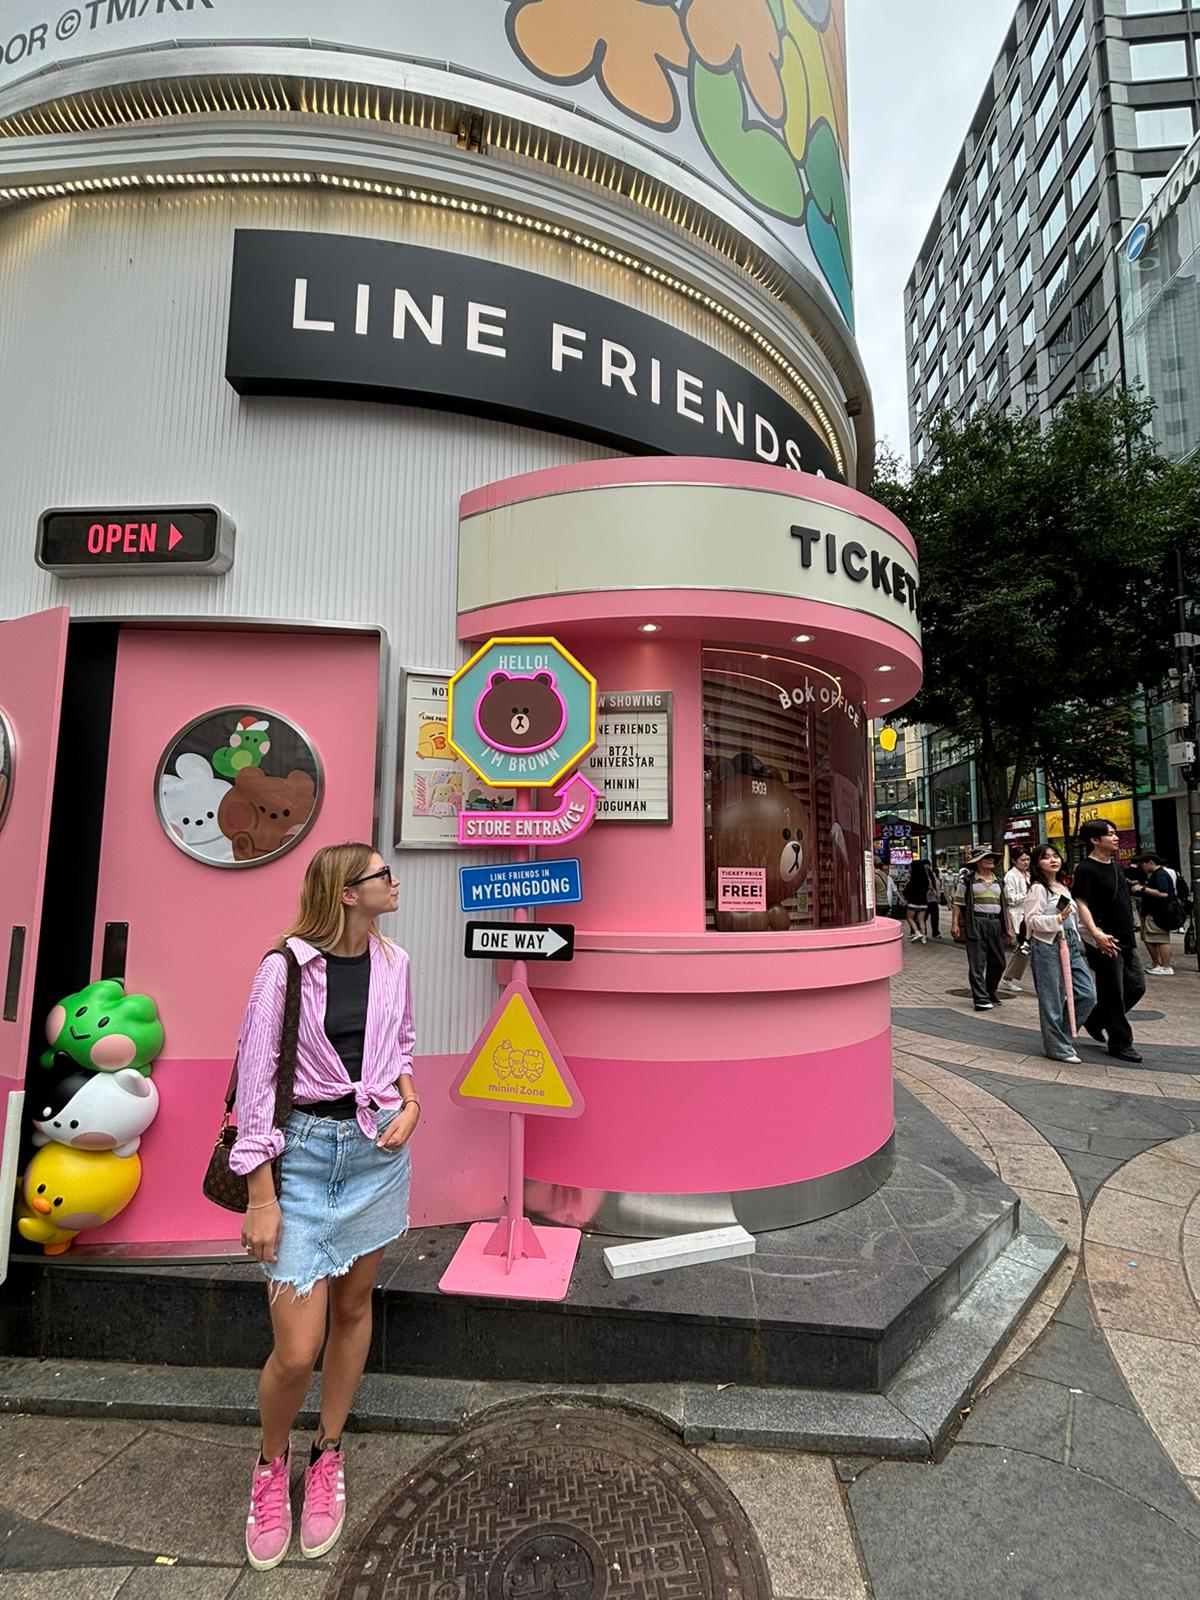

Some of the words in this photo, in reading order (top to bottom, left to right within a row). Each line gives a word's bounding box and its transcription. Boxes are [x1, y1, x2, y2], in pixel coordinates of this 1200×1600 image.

[292, 278, 507, 358] LINE
[551, 322, 802, 473] FRIENDS
[88, 523, 157, 554] OPEN
[499, 655, 550, 670] HELLO!
[610, 695, 662, 707] SHOWING
[820, 687, 860, 729] OFFICE
[614, 723, 659, 735] FRIENDS
[608, 745, 639, 757] BT21,
[481, 747, 504, 768] I'M
[508, 747, 561, 772] BROWN
[590, 756, 655, 768] UNIVERSTAR
[604, 778, 640, 790] MININI
[467, 820, 511, 837] STORE
[516, 801, 585, 837] ENTRANCE
[490, 871, 507, 882] LINE
[508, 870, 540, 880] FRIENDS
[541, 869, 550, 877] IN
[472, 877, 571, 901] MYEONGDONG
[722, 884, 763, 898] FREE!
[481, 932, 509, 949] ONE
[514, 934, 545, 950] WAY
[520, 1085, 545, 1097] Zone
